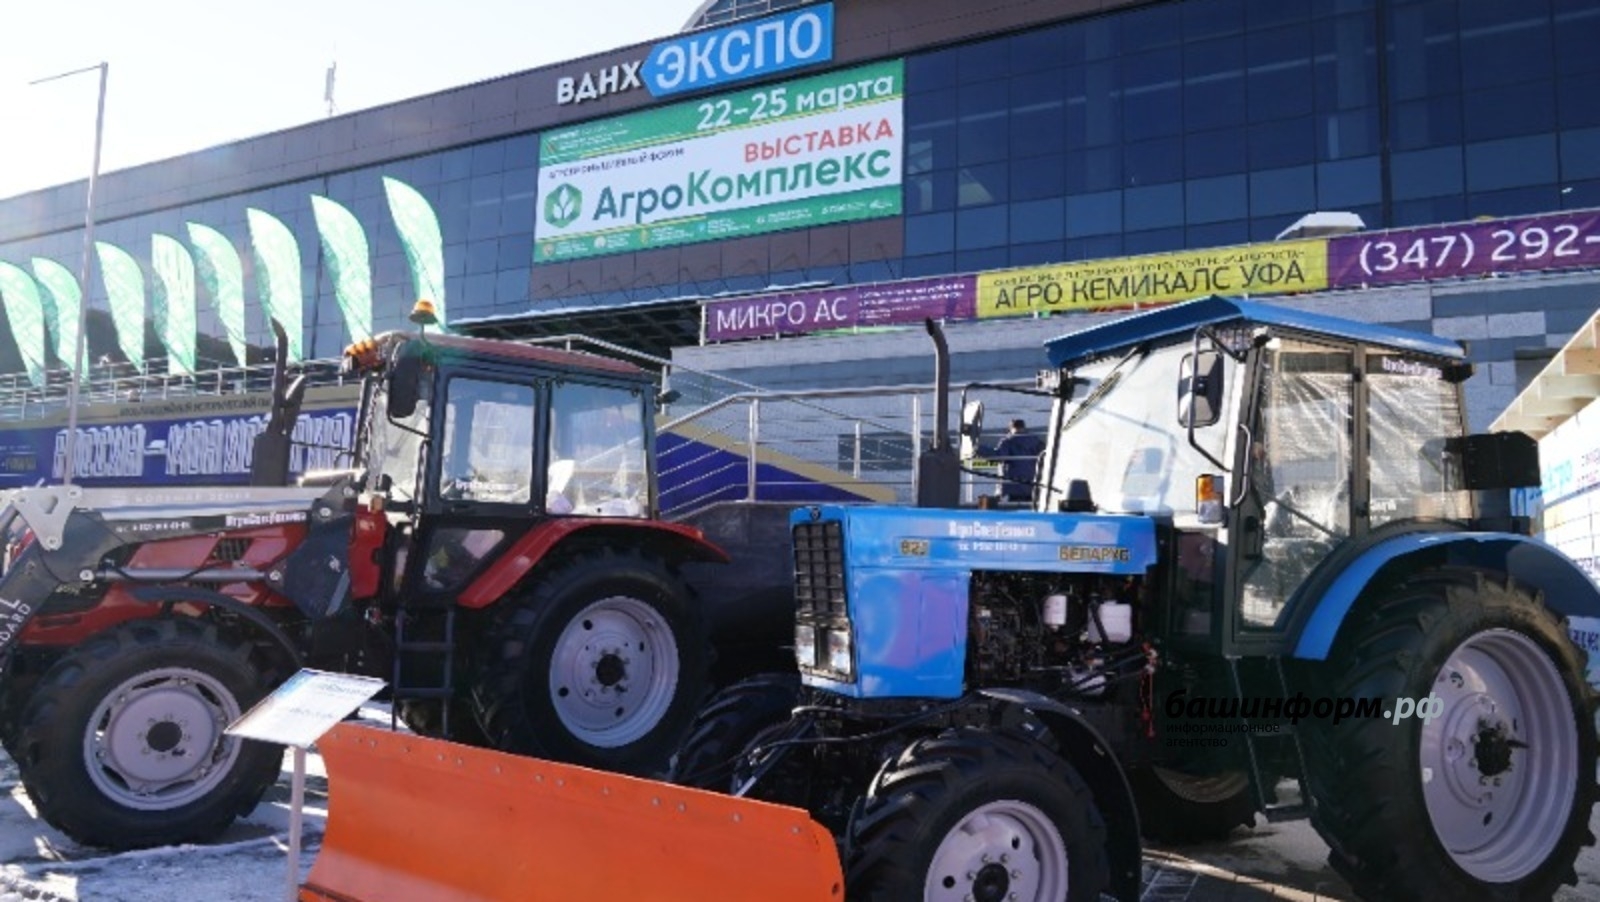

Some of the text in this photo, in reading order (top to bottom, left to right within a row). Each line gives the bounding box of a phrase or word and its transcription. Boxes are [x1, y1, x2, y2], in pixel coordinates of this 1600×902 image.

[556, 12, 823, 104] ВДНХ ЭКСПО
[796, 75, 894, 113] марта
[744, 118, 894, 164] ВЫСТАВКА
[592, 149, 892, 224] АгроКомплекс
[1359, 232, 1475, 276] (347)
[995, 283, 1064, 309] АГРО
[1072, 265, 1232, 303] КЕМИКАЛС
[1241, 259, 1305, 289] УФА
[716, 299, 806, 332] МИКРО
[813, 296, 848, 322] АС
